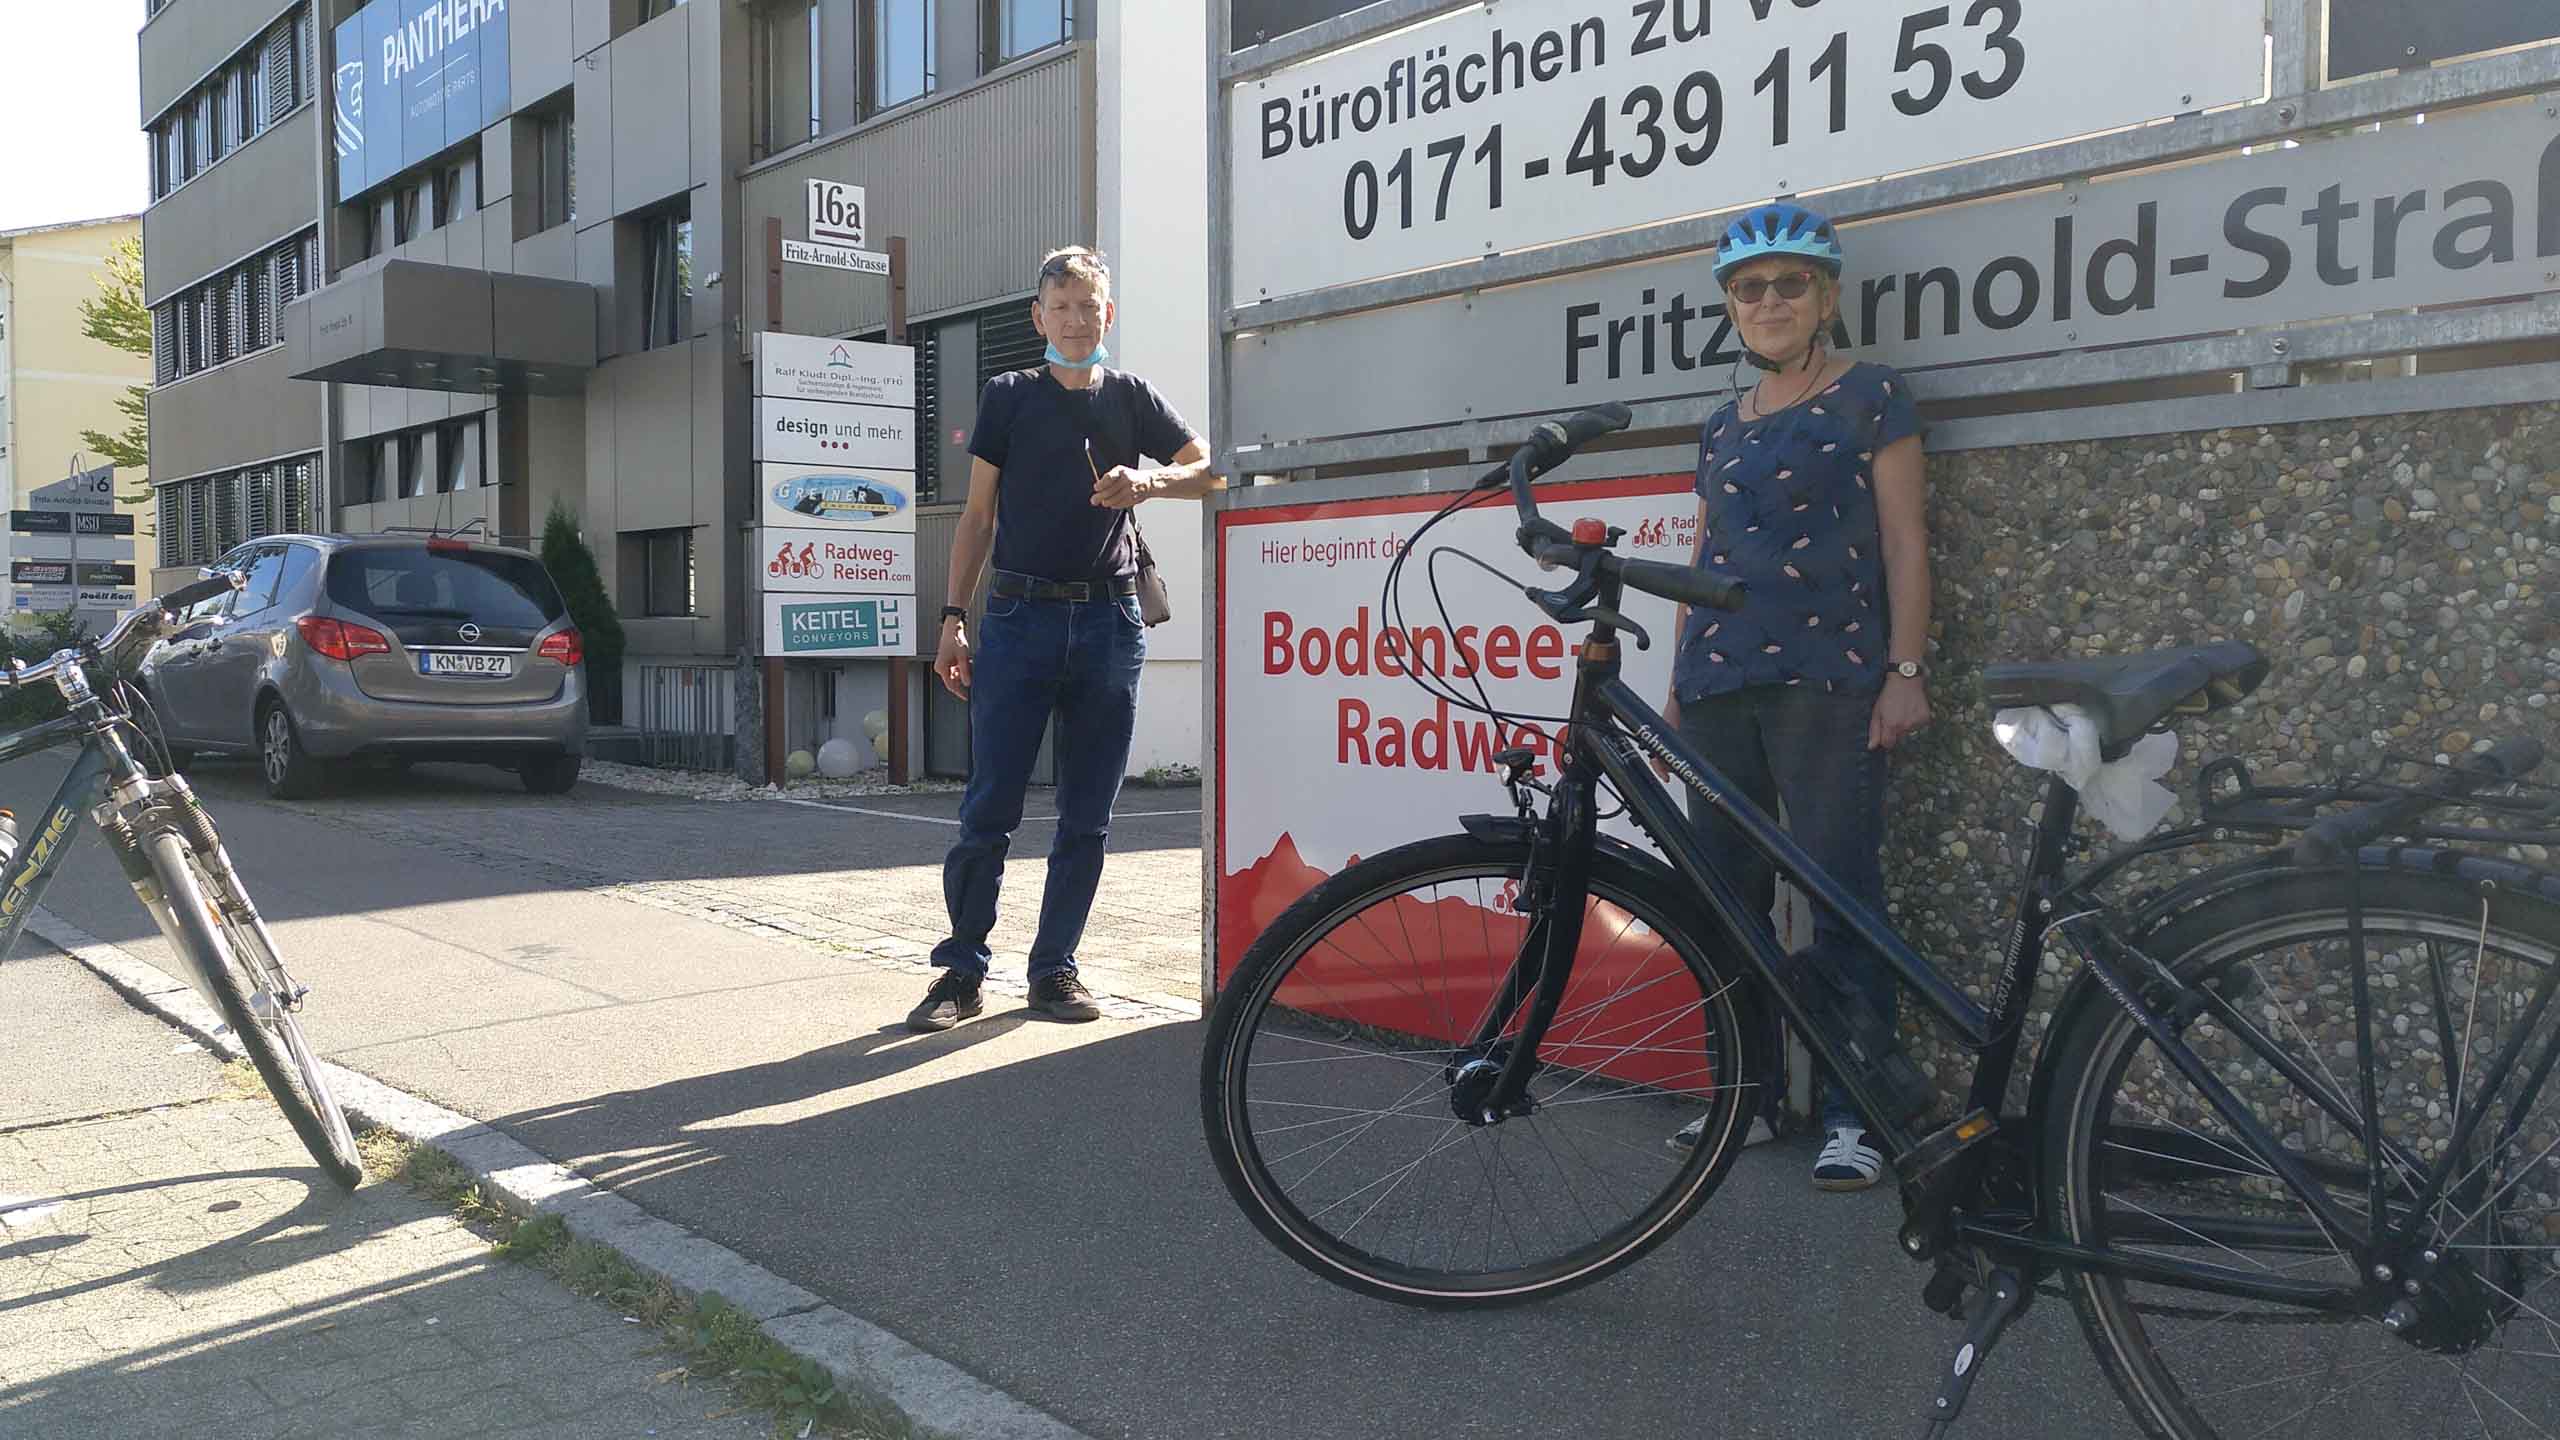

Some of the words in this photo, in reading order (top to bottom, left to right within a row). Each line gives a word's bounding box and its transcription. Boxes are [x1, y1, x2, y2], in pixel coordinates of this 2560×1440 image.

[1260, 16, 1606, 161] Büroflächen
[1631, 0, 1711, 57] zu
[1753, 31, 1848, 147] 11
[1891, 0, 2026, 118] 53
[813, 182, 862, 230] 16a
[785, 243, 887, 272] Fritz-Arnold-Strasse
[775, 367, 796, 377] Ralf
[776, 416, 828, 438] design
[835, 421, 861, 438] und
[779, 483, 868, 503] GREINER
[1671, 514, 1699, 529] Rad
[825, 543, 900, 566] Radweg-
[1261, 540, 1297, 564] Hier
[1302, 534, 1377, 568] beginnt
[834, 563, 911, 583] Reisen.com
[792, 609, 868, 632] KEITEL
[793, 631, 869, 644] CONVEYORS
[436, 655, 456, 671] KN
[465, 656, 485, 671] VB
[488, 657, 505, 671] 27
